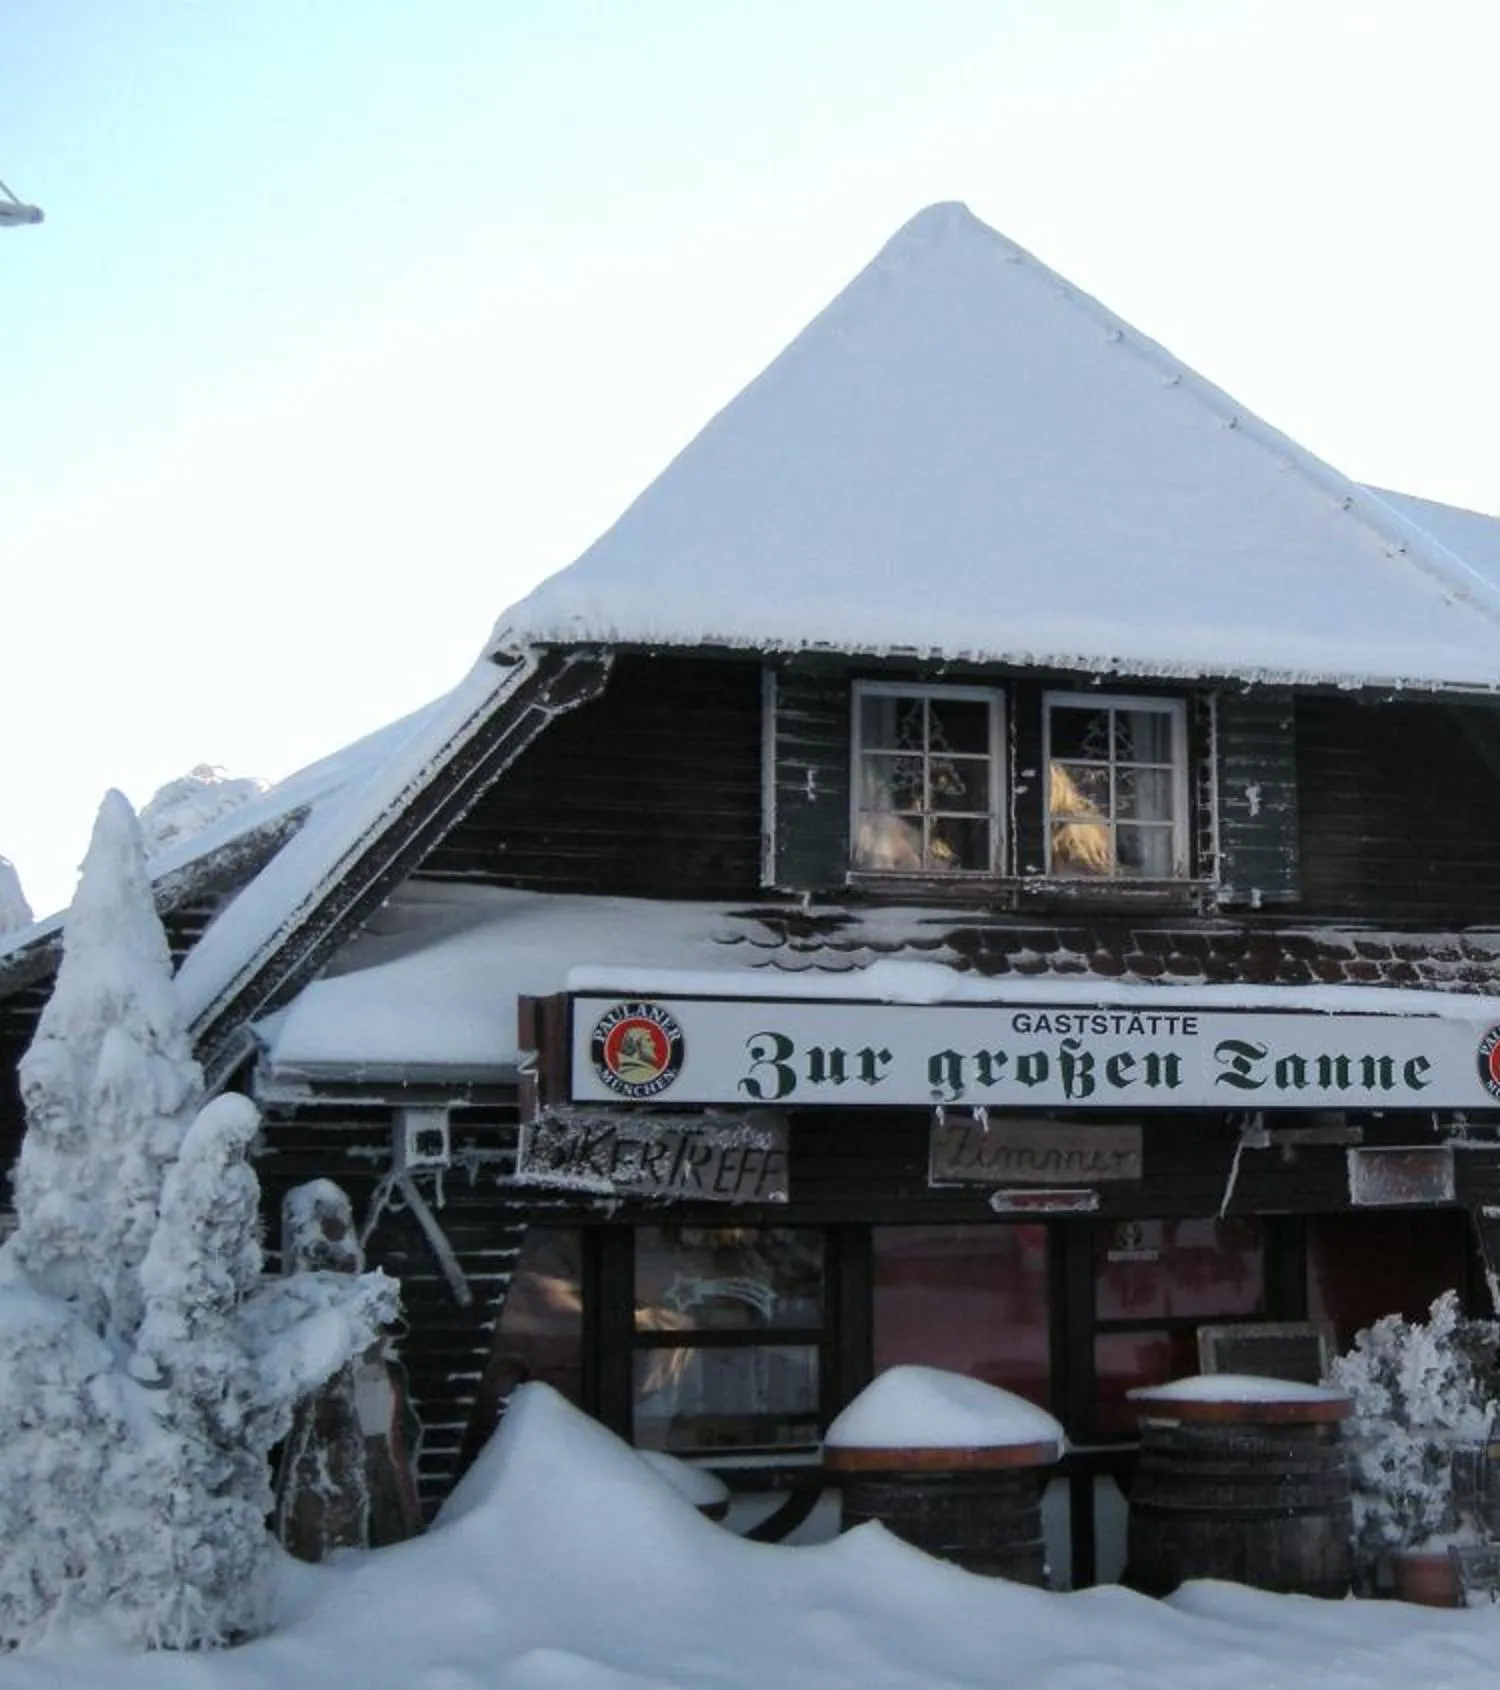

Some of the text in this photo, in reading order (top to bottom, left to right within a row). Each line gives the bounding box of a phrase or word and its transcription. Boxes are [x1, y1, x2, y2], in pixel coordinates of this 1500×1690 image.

[593, 1003, 681, 1042] PAULANER
[1011, 1011, 1200, 1036] GASTSTÄTTE
[738, 1031, 1433, 1101] Zur großen Tanne
[946, 1125, 1137, 1172] Zimmer
